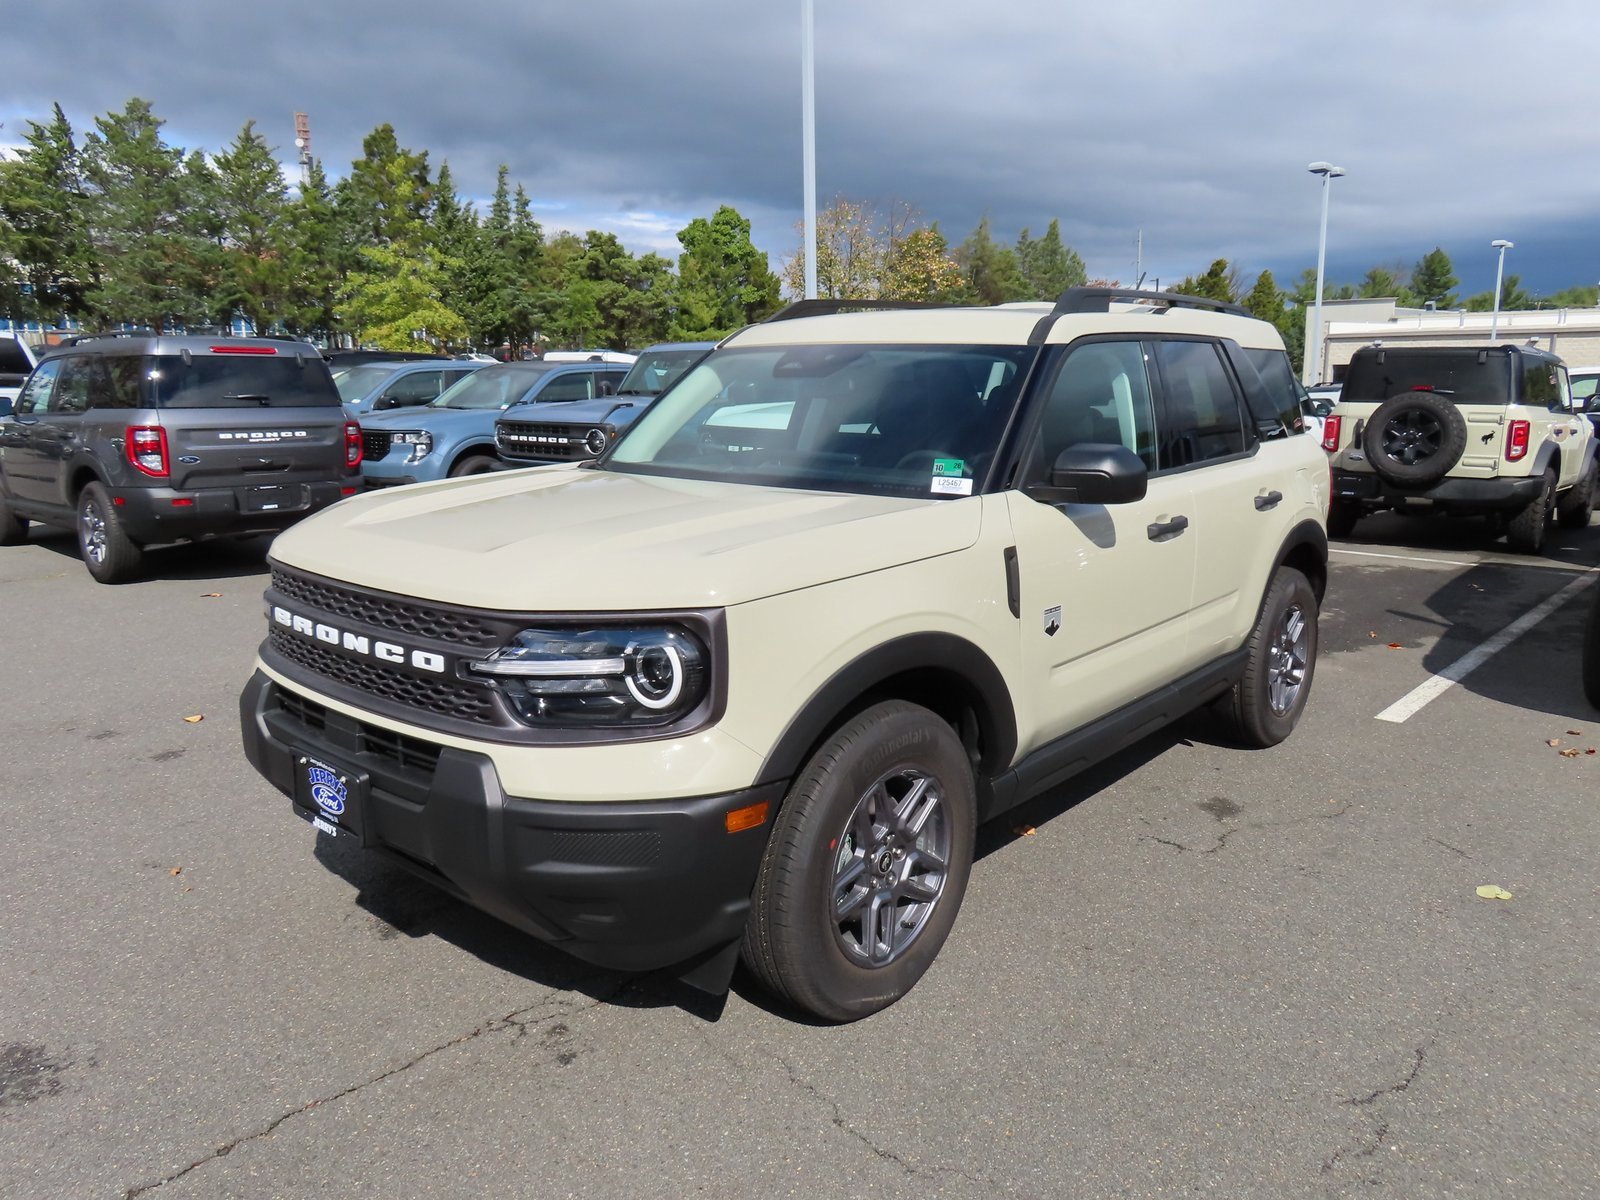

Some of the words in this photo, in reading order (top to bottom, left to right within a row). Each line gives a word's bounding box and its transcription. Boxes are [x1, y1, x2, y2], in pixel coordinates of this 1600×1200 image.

[219, 431, 307, 439] BRONCO
[510, 435, 568, 443] BRONCO
[274, 606, 445, 673] BRONCO
[308, 767, 347, 800] JERRY'S
[313, 816, 337, 837] JERRY'S
